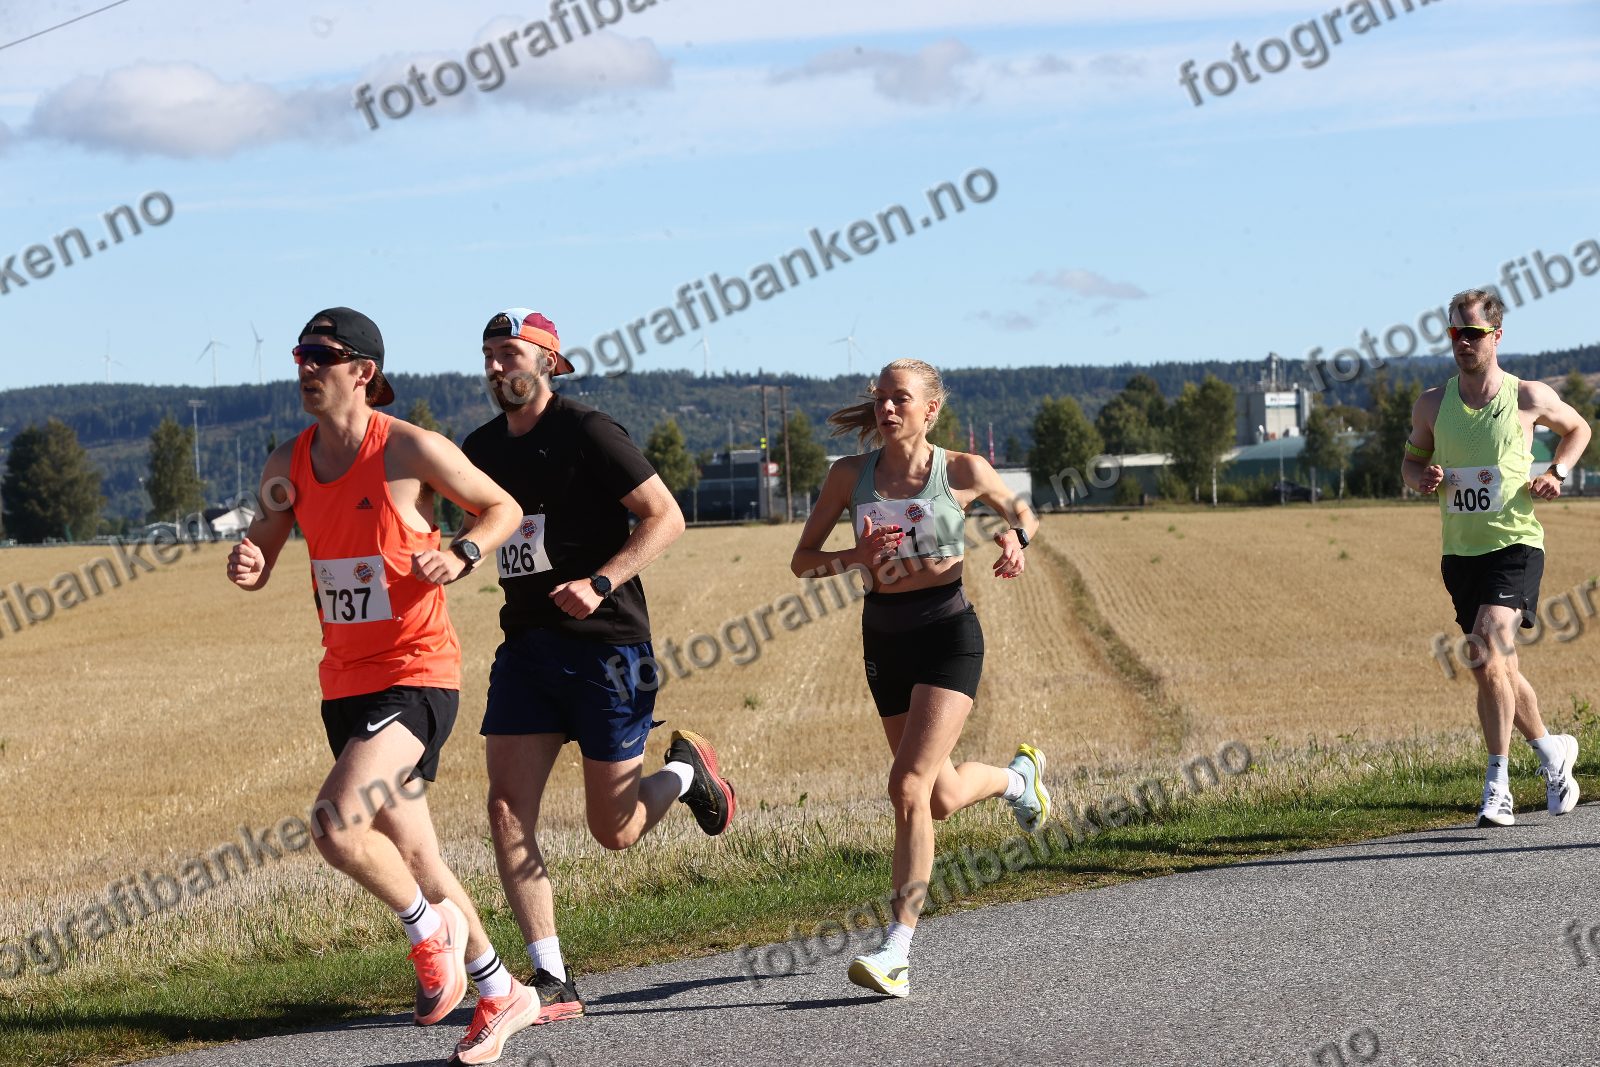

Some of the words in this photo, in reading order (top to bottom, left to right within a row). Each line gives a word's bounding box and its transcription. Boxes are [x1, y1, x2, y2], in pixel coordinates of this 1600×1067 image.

[1454, 487, 1490, 511] 406
[501, 543, 535, 574] 426
[326, 587, 371, 621] 737
